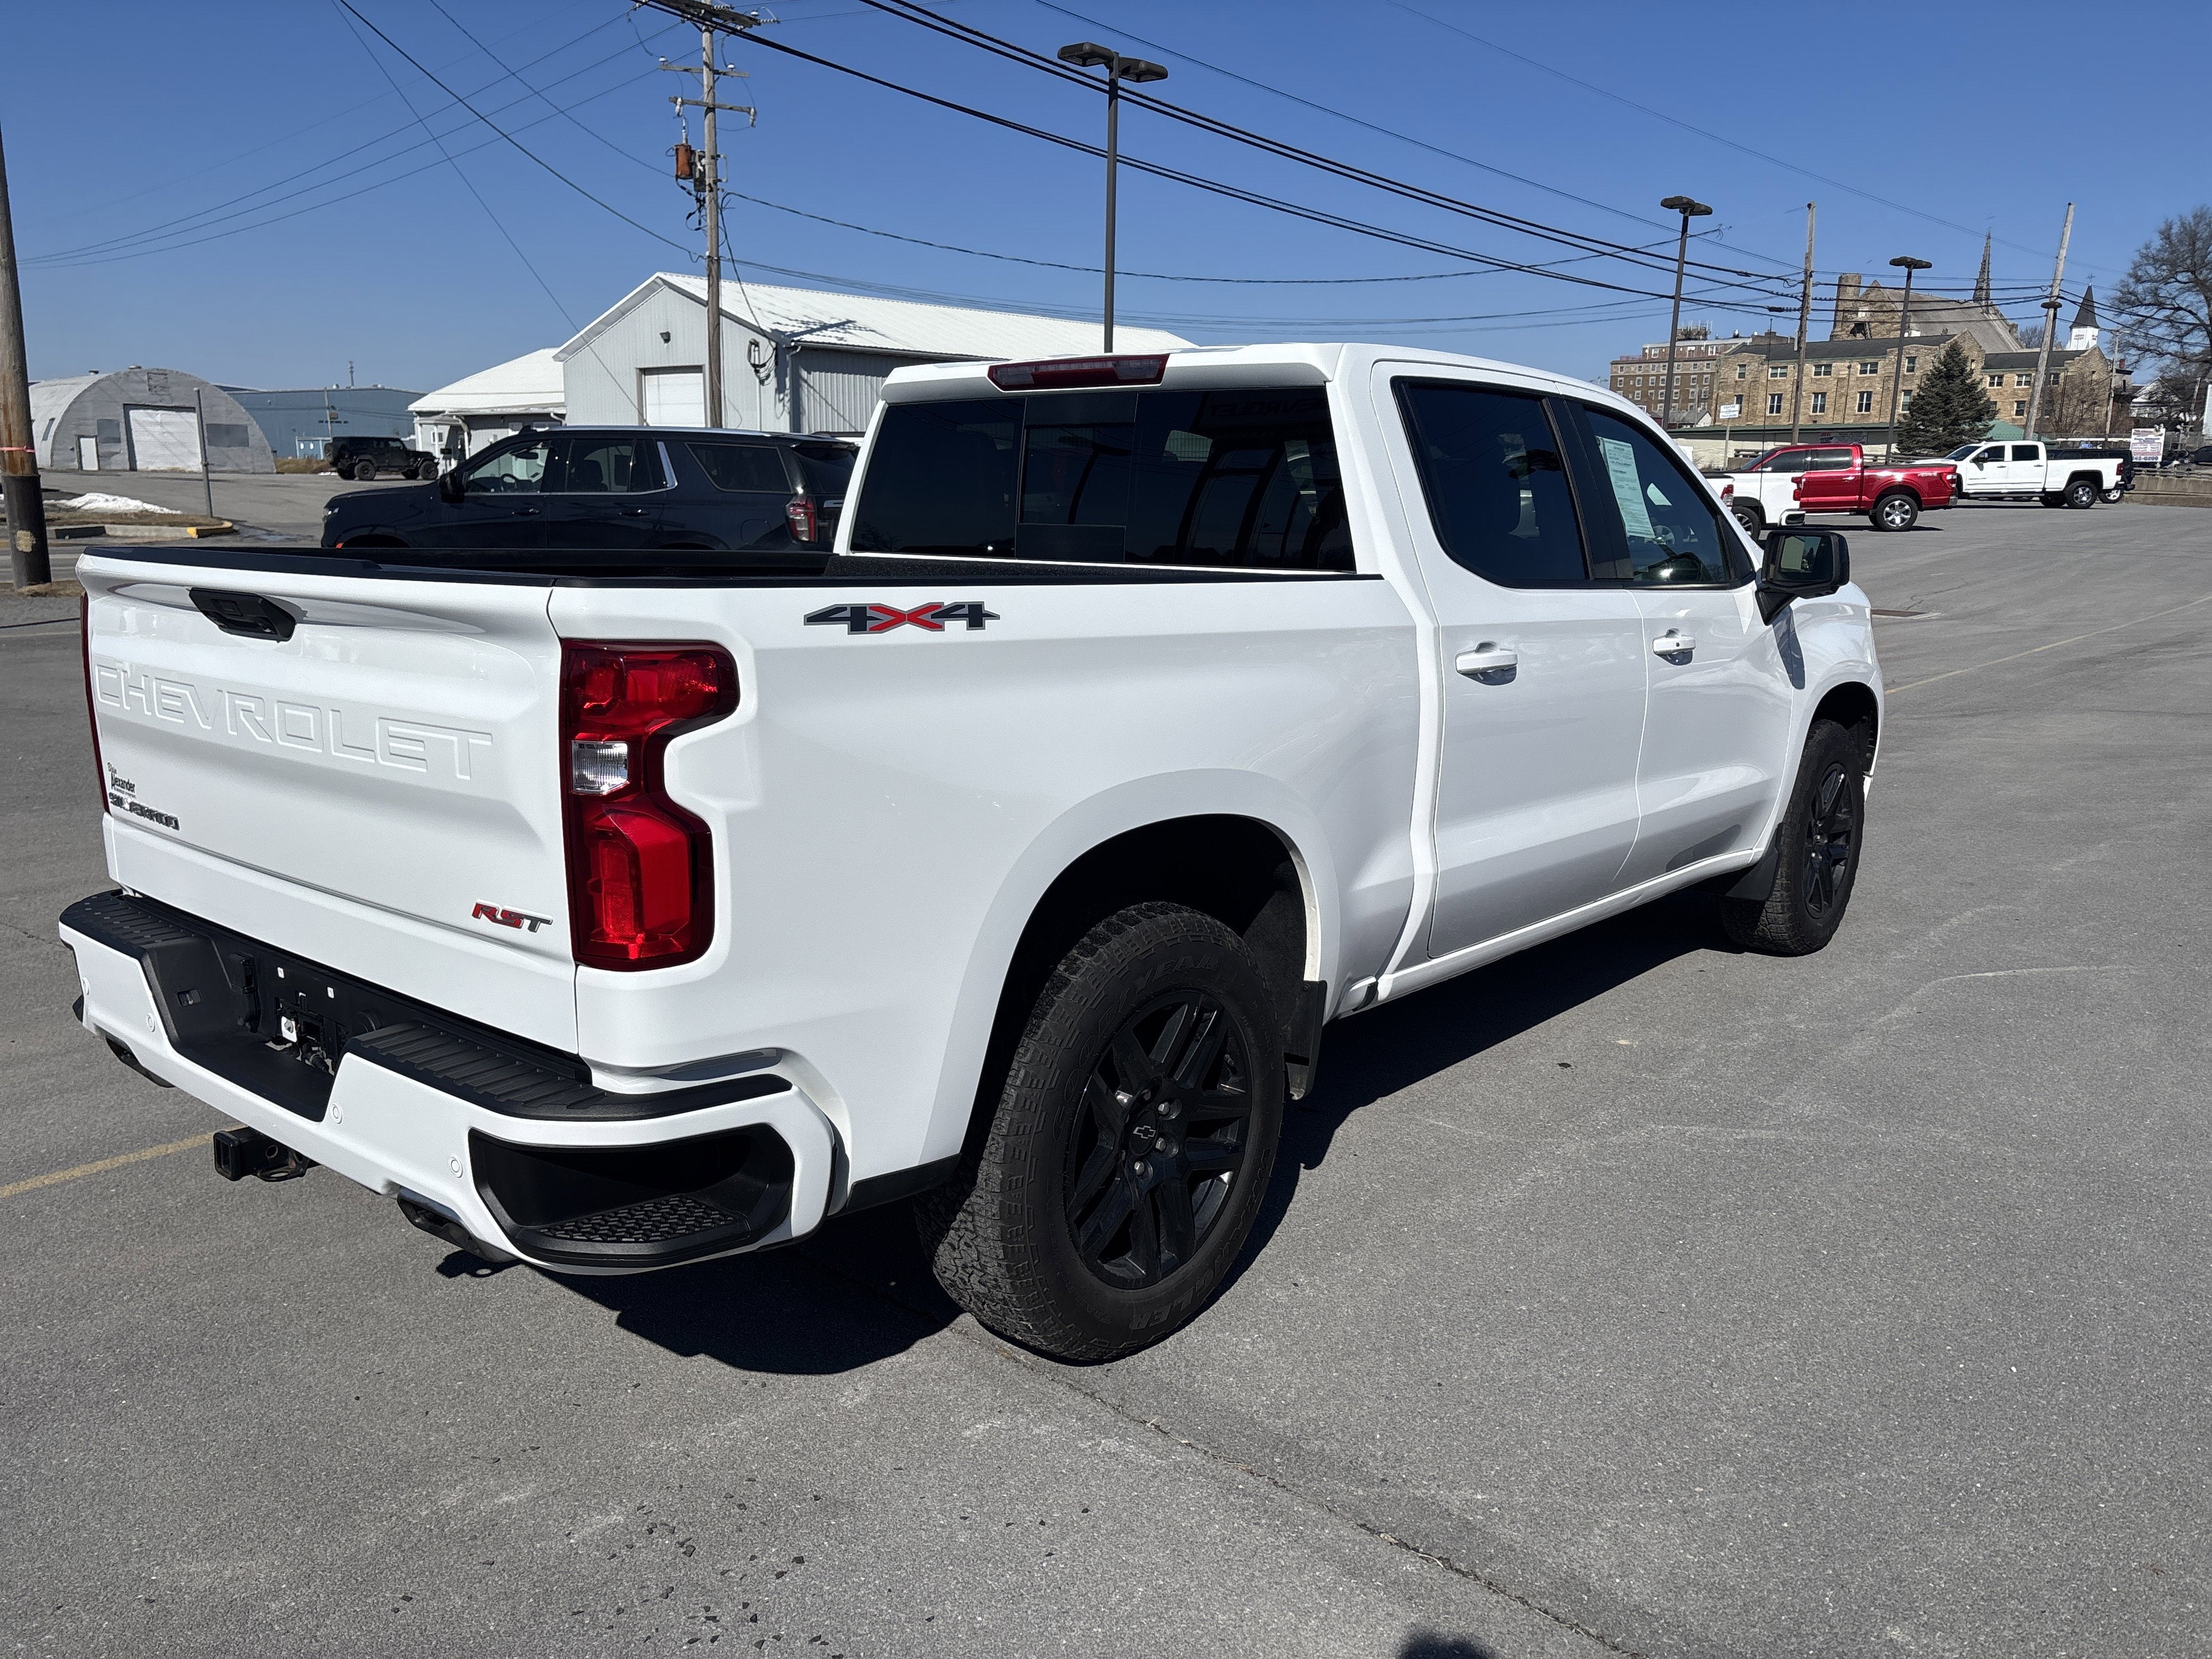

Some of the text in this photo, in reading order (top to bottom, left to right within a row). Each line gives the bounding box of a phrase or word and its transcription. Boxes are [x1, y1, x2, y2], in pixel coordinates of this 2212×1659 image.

[95, 664, 493, 780] CHEVROLET
[471, 901, 553, 933] RST
[1053, 955, 1220, 1142] GOODYEAR
[1128, 1148, 1274, 1330] WRANGLER
